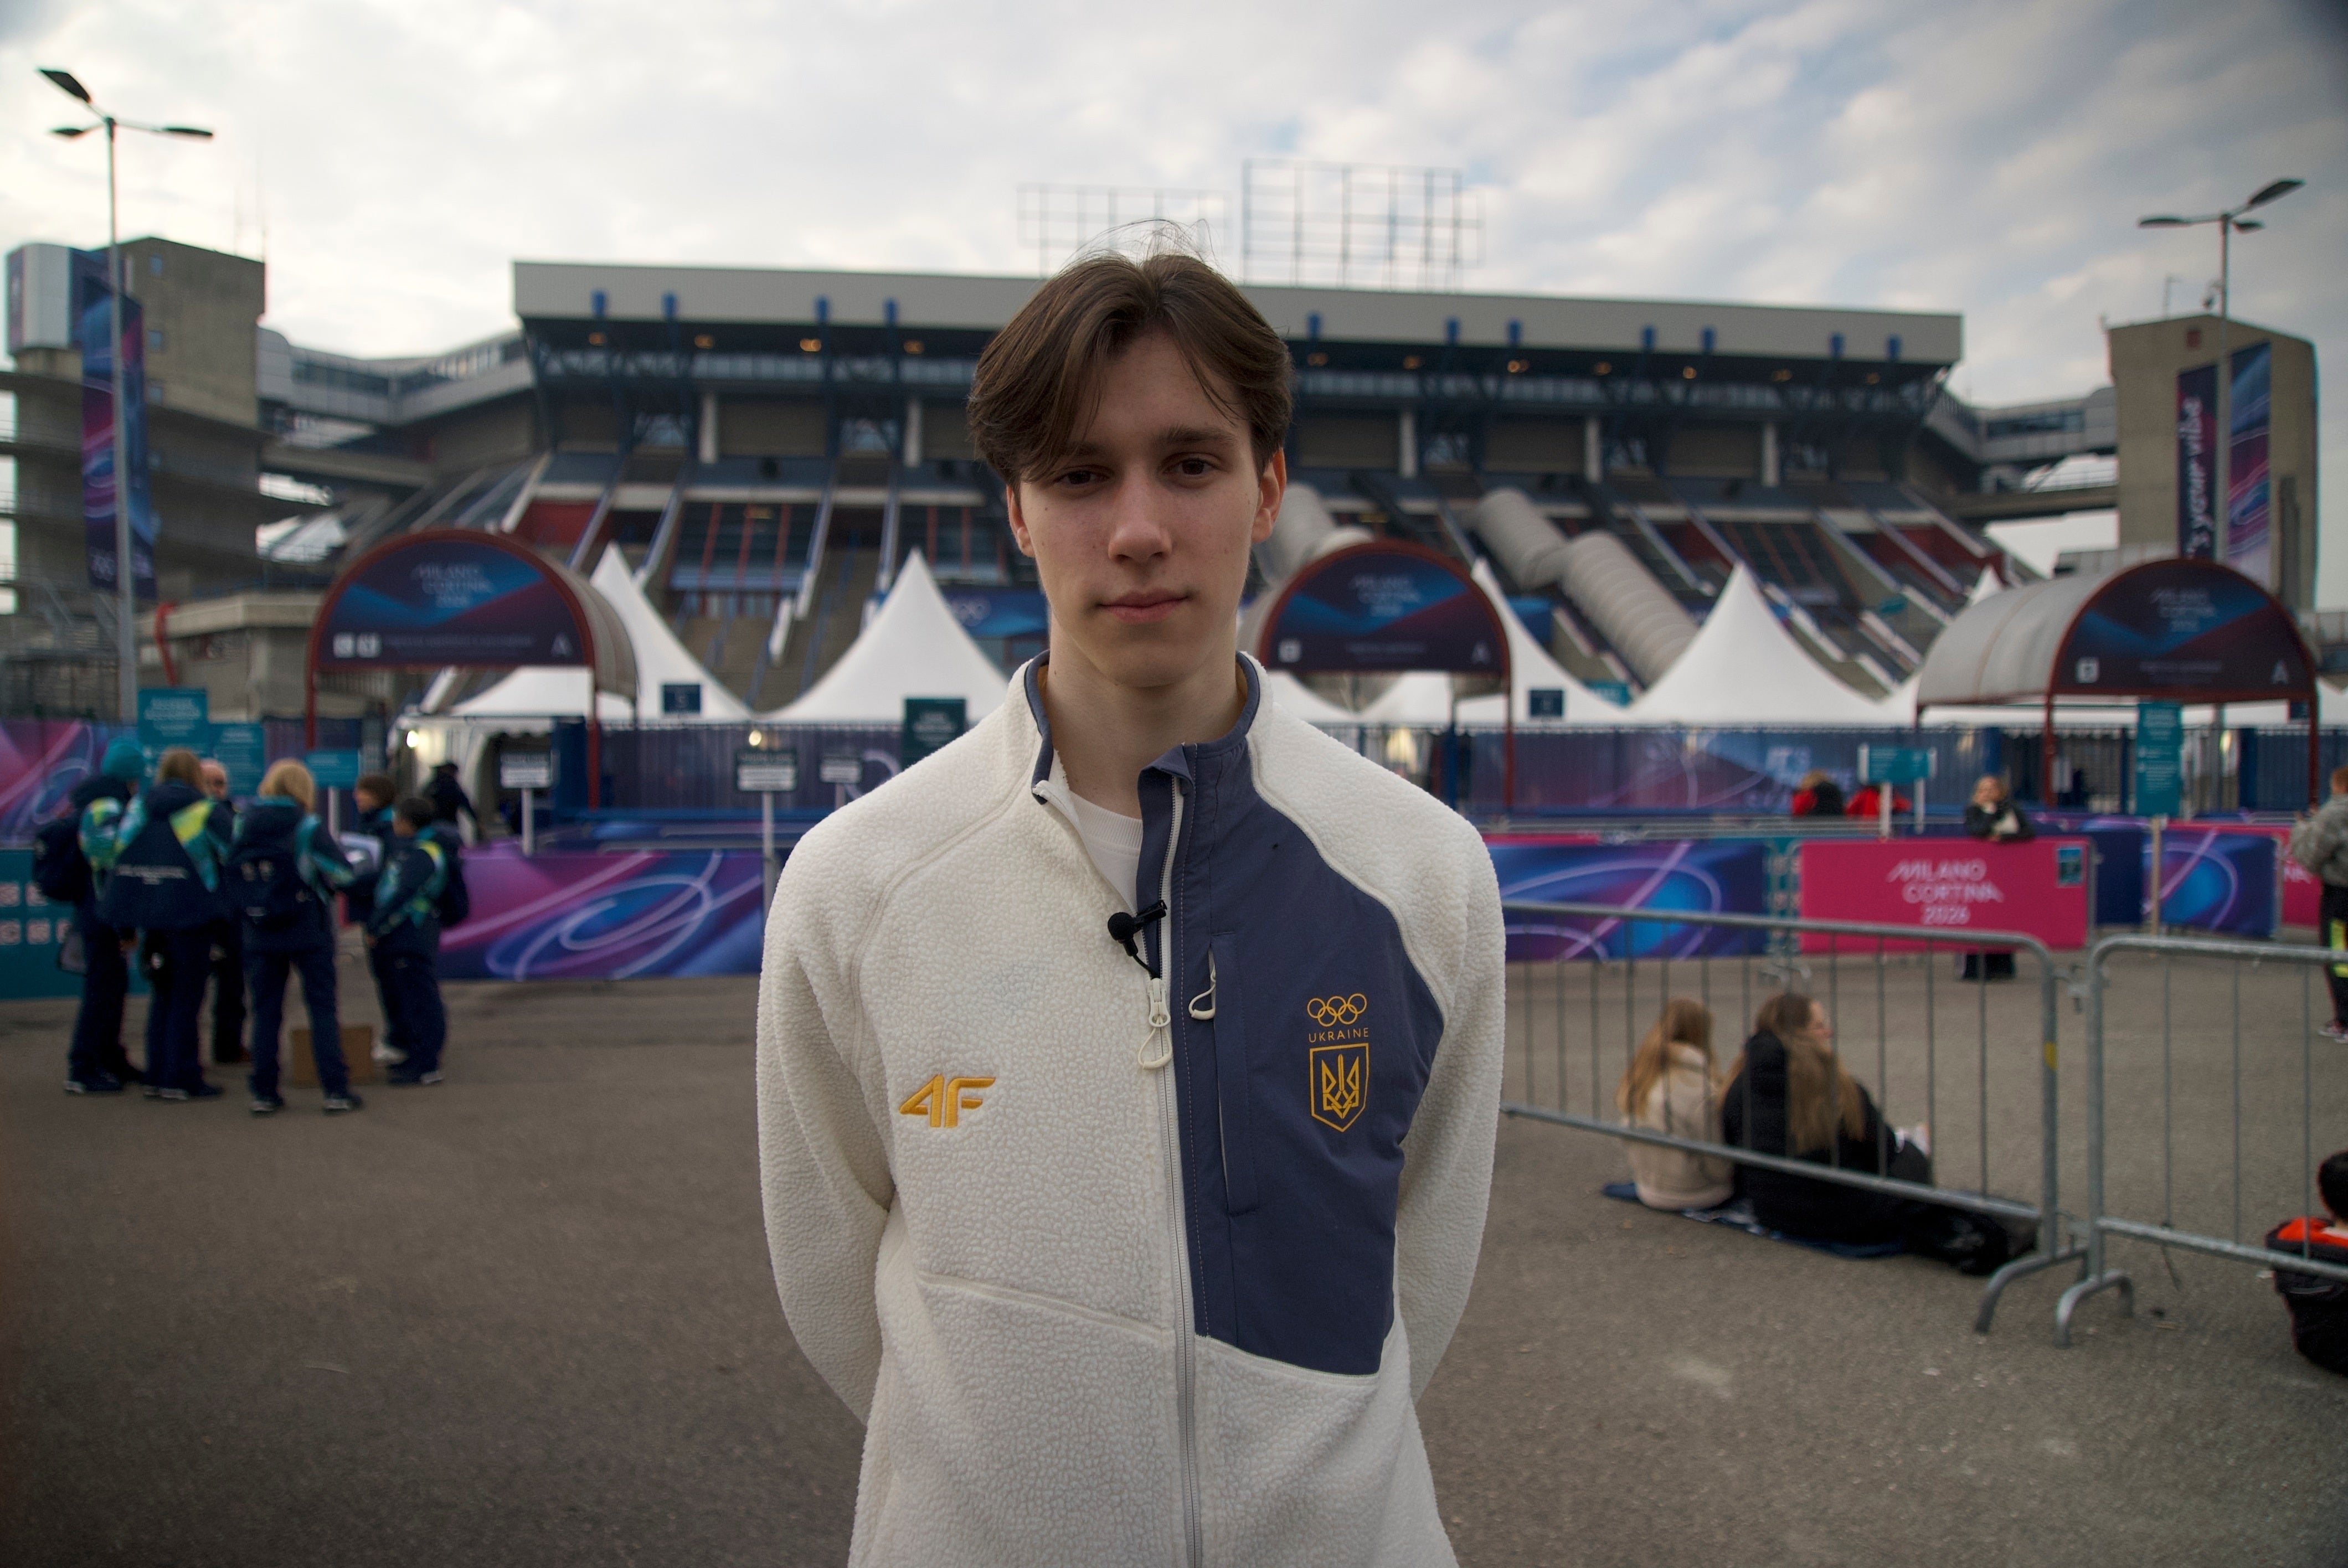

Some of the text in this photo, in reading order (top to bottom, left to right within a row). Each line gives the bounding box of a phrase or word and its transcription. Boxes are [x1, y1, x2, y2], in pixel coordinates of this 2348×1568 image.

[2177, 397, 2203, 456] vibe
[2188, 458, 2215, 530] your
[1886, 859, 1986, 883] MILANO
[1903, 881, 2004, 904] CORTINA
[1923, 906, 1970, 925] 2026
[1309, 1028, 1369, 1043] UKRAINE
[899, 1074, 996, 1128] 4F
